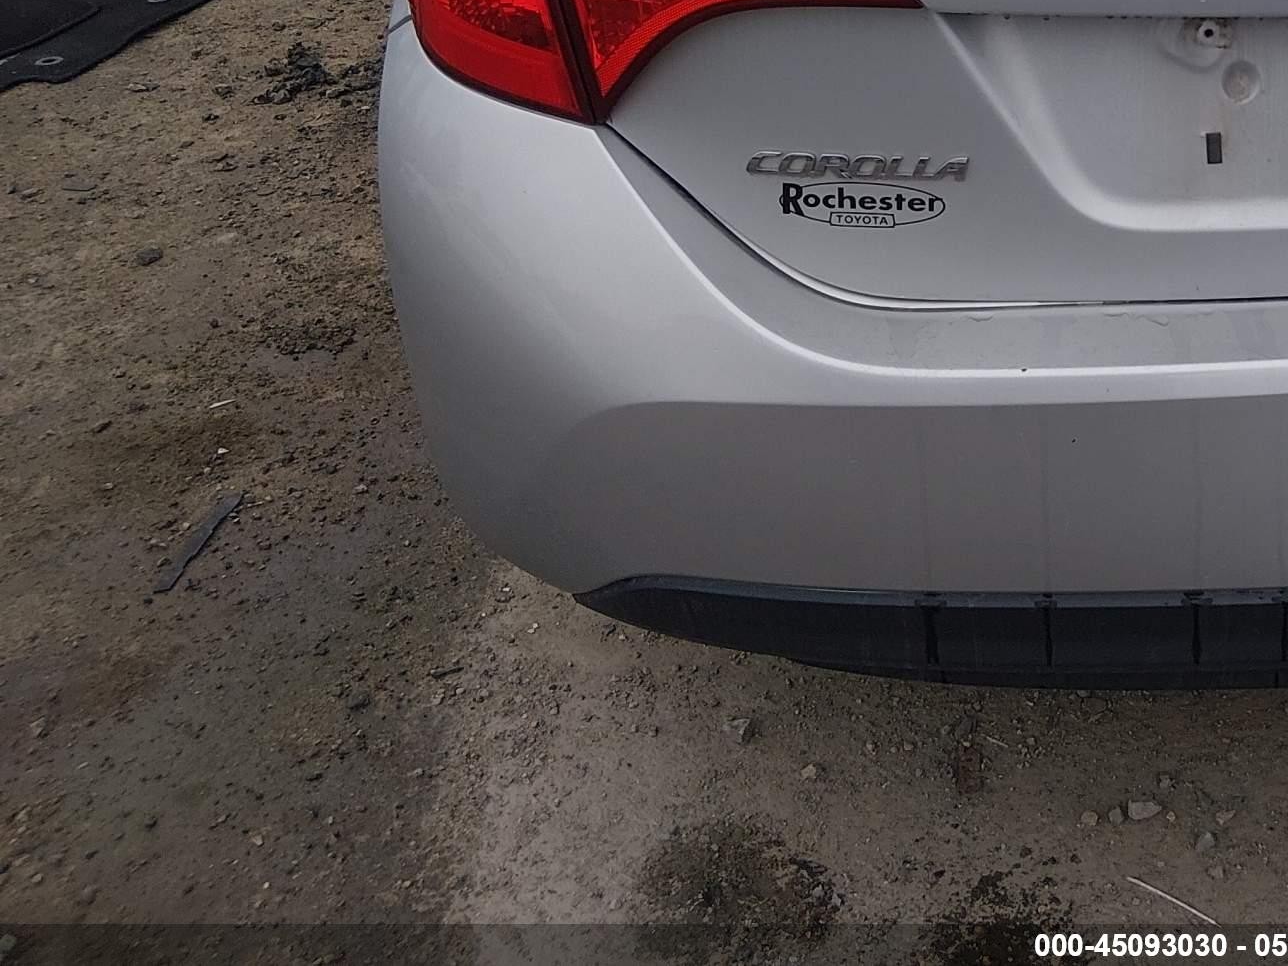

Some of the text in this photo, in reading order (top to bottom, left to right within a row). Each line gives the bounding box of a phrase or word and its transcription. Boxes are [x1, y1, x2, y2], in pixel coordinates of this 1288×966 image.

[746, 150, 969, 182] COROLLA
[782, 182, 943, 217] Rochester
[835, 214, 889, 226] TOYOTA
